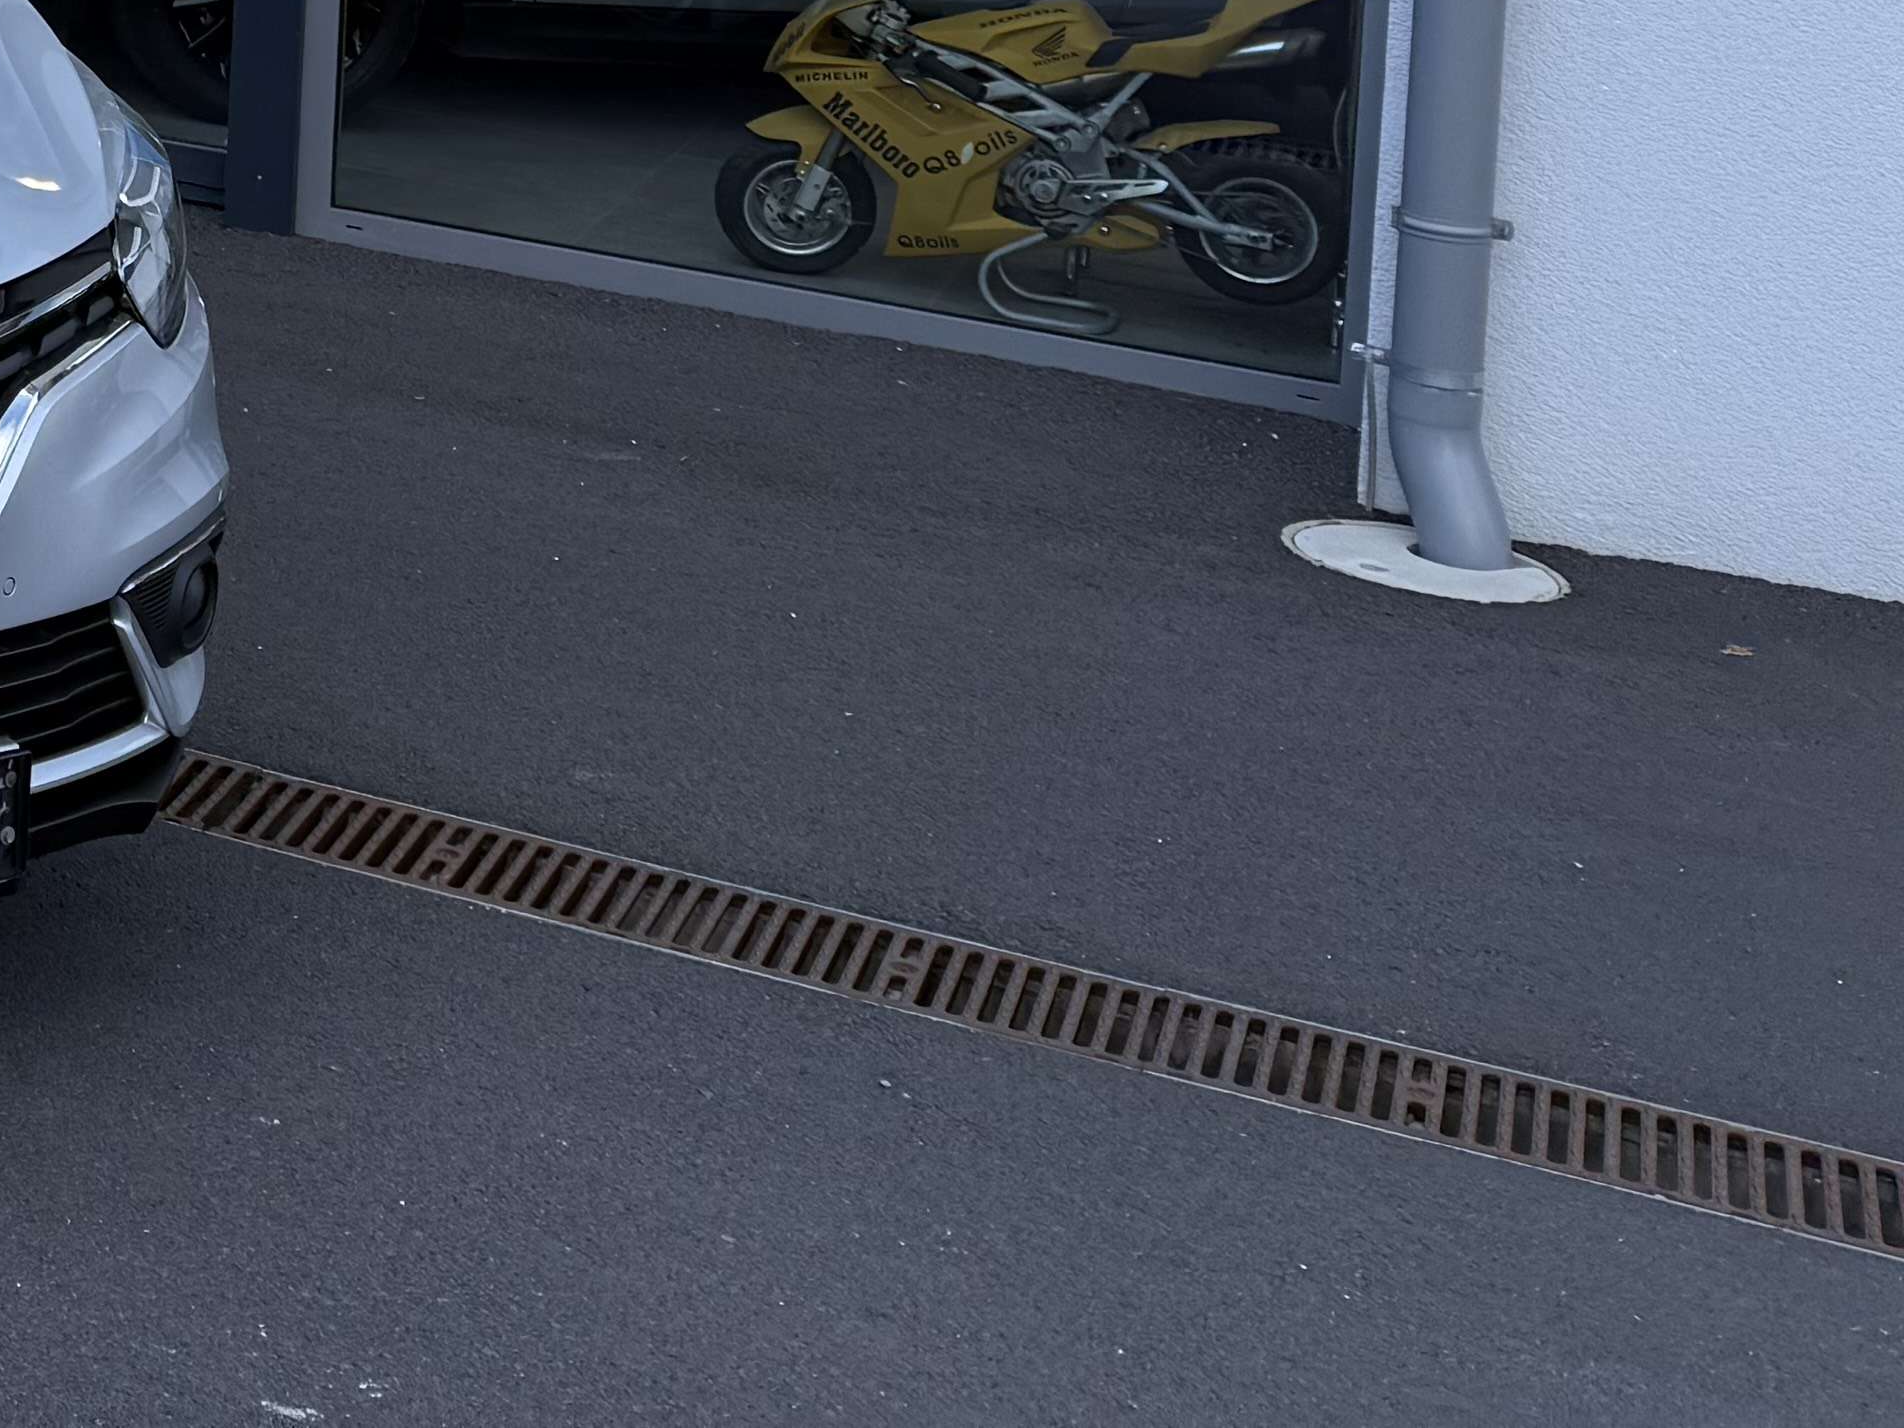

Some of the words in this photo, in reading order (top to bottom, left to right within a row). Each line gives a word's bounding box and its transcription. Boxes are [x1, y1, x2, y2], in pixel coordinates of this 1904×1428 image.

[979, 5, 1068, 28] HONDA
[794, 70, 869, 84] MICHELIN
[822, 91, 922, 179] Marlboro
